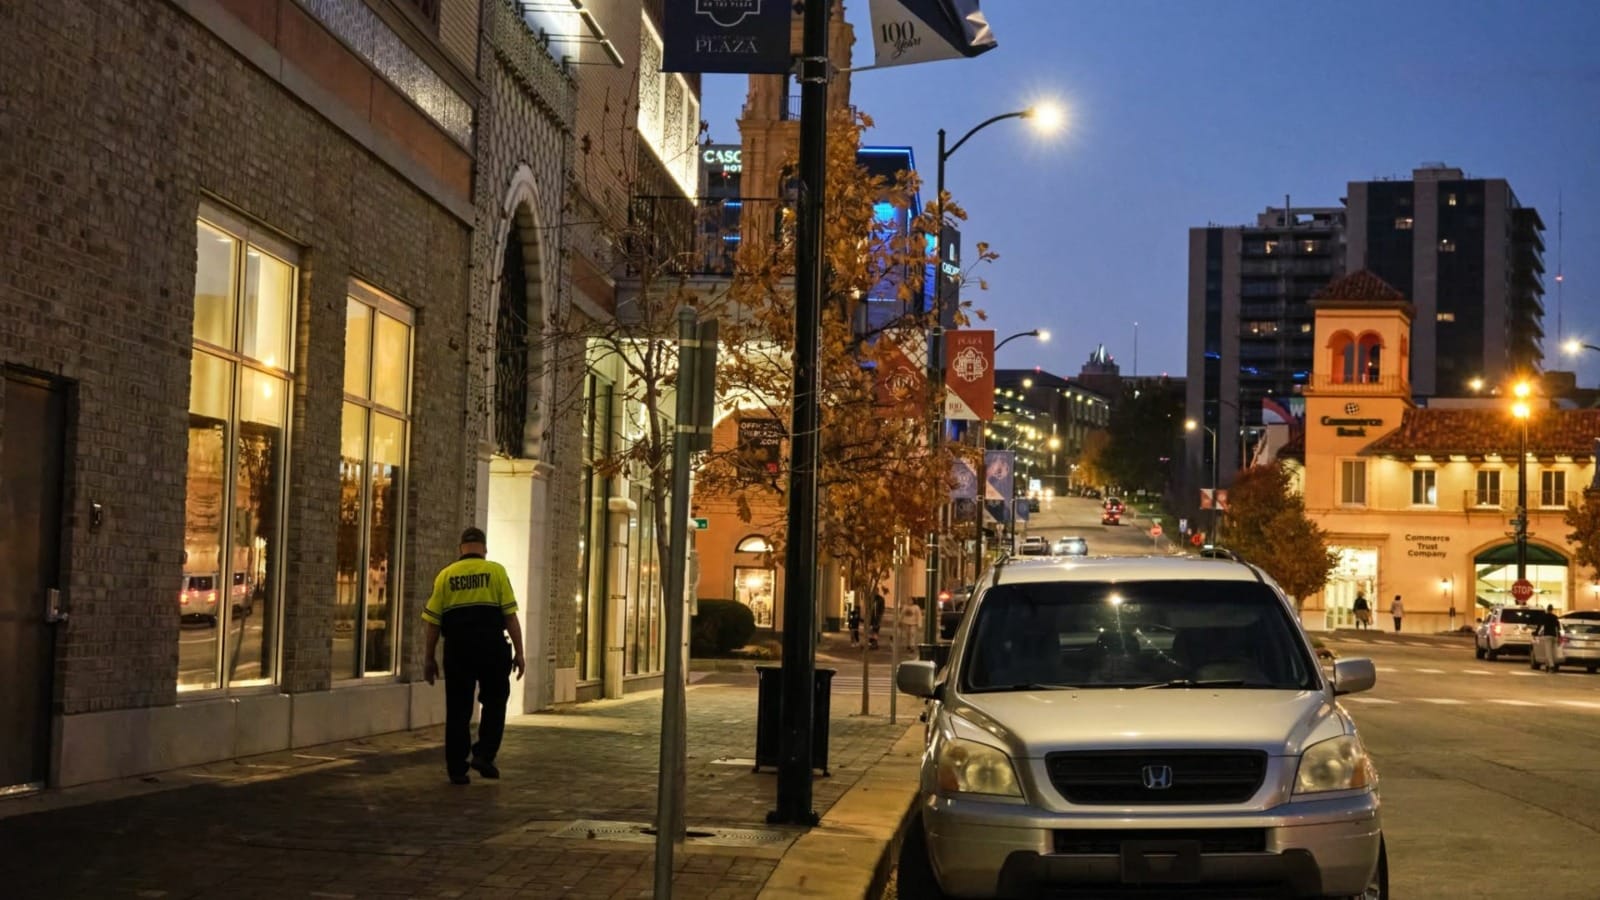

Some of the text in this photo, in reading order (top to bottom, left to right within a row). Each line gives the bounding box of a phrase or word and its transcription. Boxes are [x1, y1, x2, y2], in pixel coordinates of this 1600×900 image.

[882, 20, 914, 43] 100
[695, 39, 758, 53] PLAZA
[1321, 416, 1383, 426] Commerce
[1405, 534, 1450, 542] Commerce
[1417, 542, 1438, 550] Trust
[1407, 550, 1447, 559] Company
[449, 572, 491, 592] SECURITY
[1513, 585, 1533, 595] STOP
